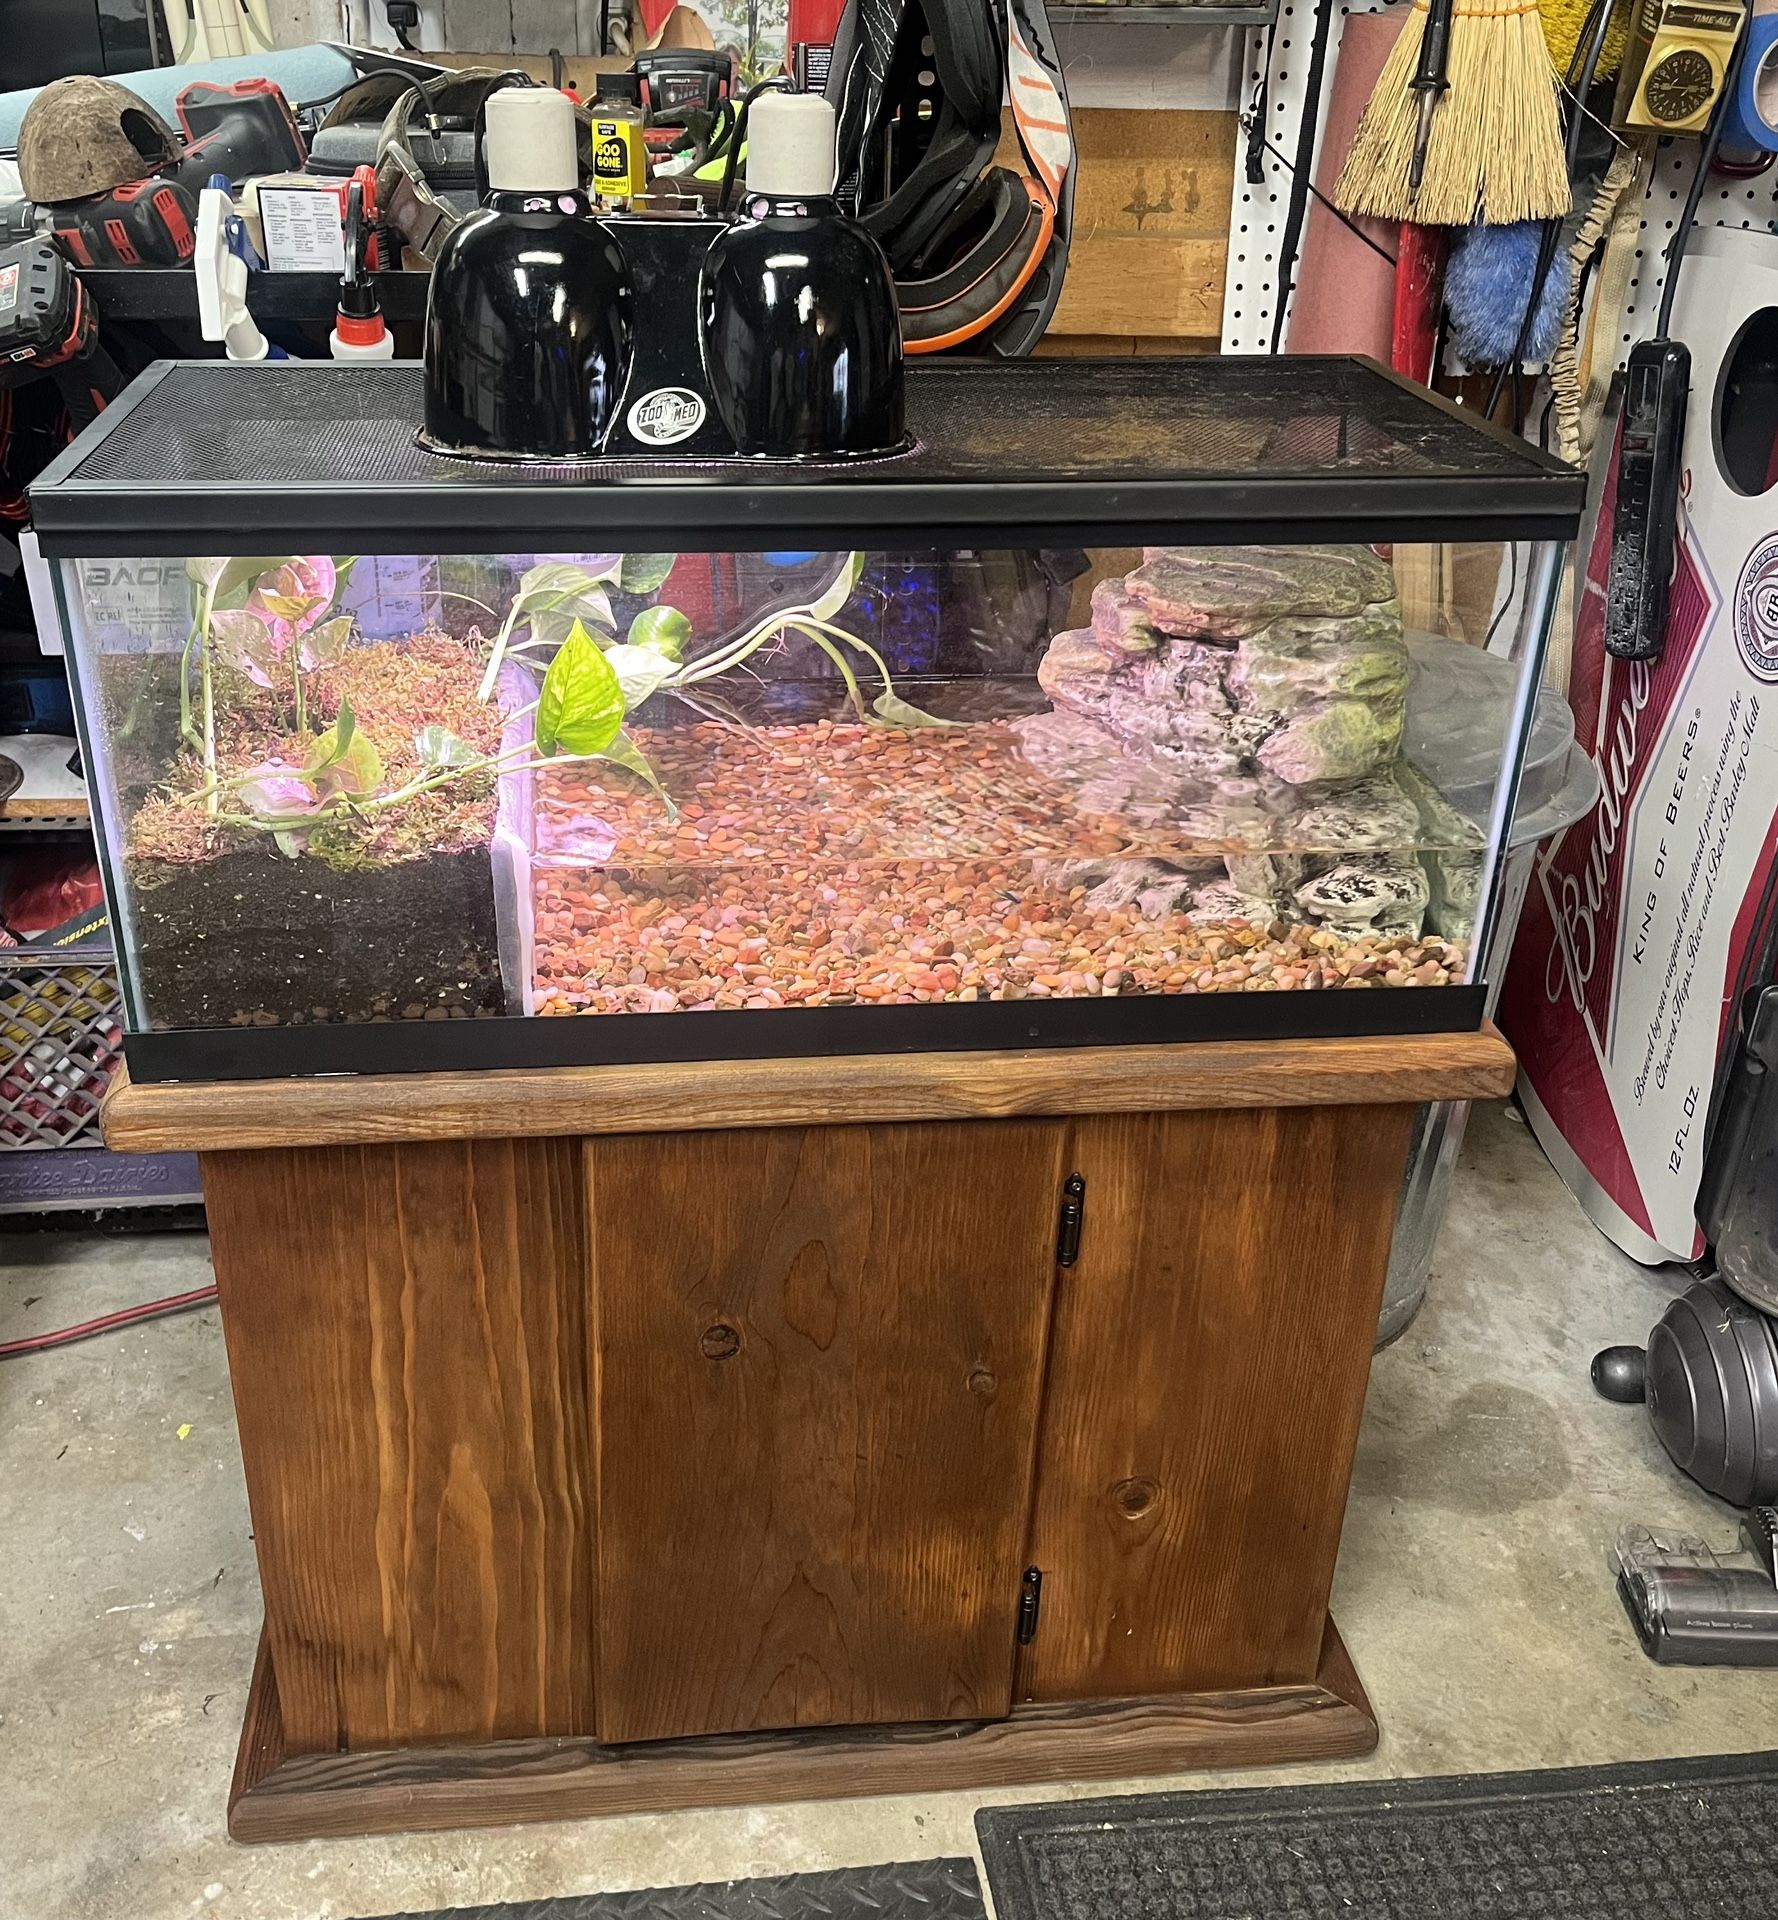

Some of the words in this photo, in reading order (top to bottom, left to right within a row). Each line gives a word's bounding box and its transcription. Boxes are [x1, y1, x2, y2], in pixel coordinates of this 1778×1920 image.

[596, 142, 621, 157] GOO
[596, 156, 621, 168] GONE
[640, 405, 663, 424] ZOO
[673, 403, 697, 422] MED
[1632, 891, 1657, 964] KING
[1654, 837, 1668, 879] OF
[1633, 1033, 1655, 1106] Brewed
[1650, 1017, 1662, 1040] by
[1659, 990, 1668, 1020] our
[1665, 917, 1684, 988] original
[1675, 890, 1690, 923] all
[1688, 826, 1706, 904] natural
[1703, 771, 1722, 841] process
[1718, 720, 1736, 771] using
[1730, 690, 1742, 721] the
[1655, 1021, 1678, 1090] Choicest
[1686, 919, 1704, 968] Rice
[1700, 875, 1714, 922] and
[1708, 827, 1726, 882] Best
[1721, 756, 1747, 832] Barley
[1741, 695, 1760, 757] Malt
[1668, 1150, 1682, 1175] 12
[1683, 1085, 1700, 1118] OZ.
[68, 1158, 169, 1185] Dairies
